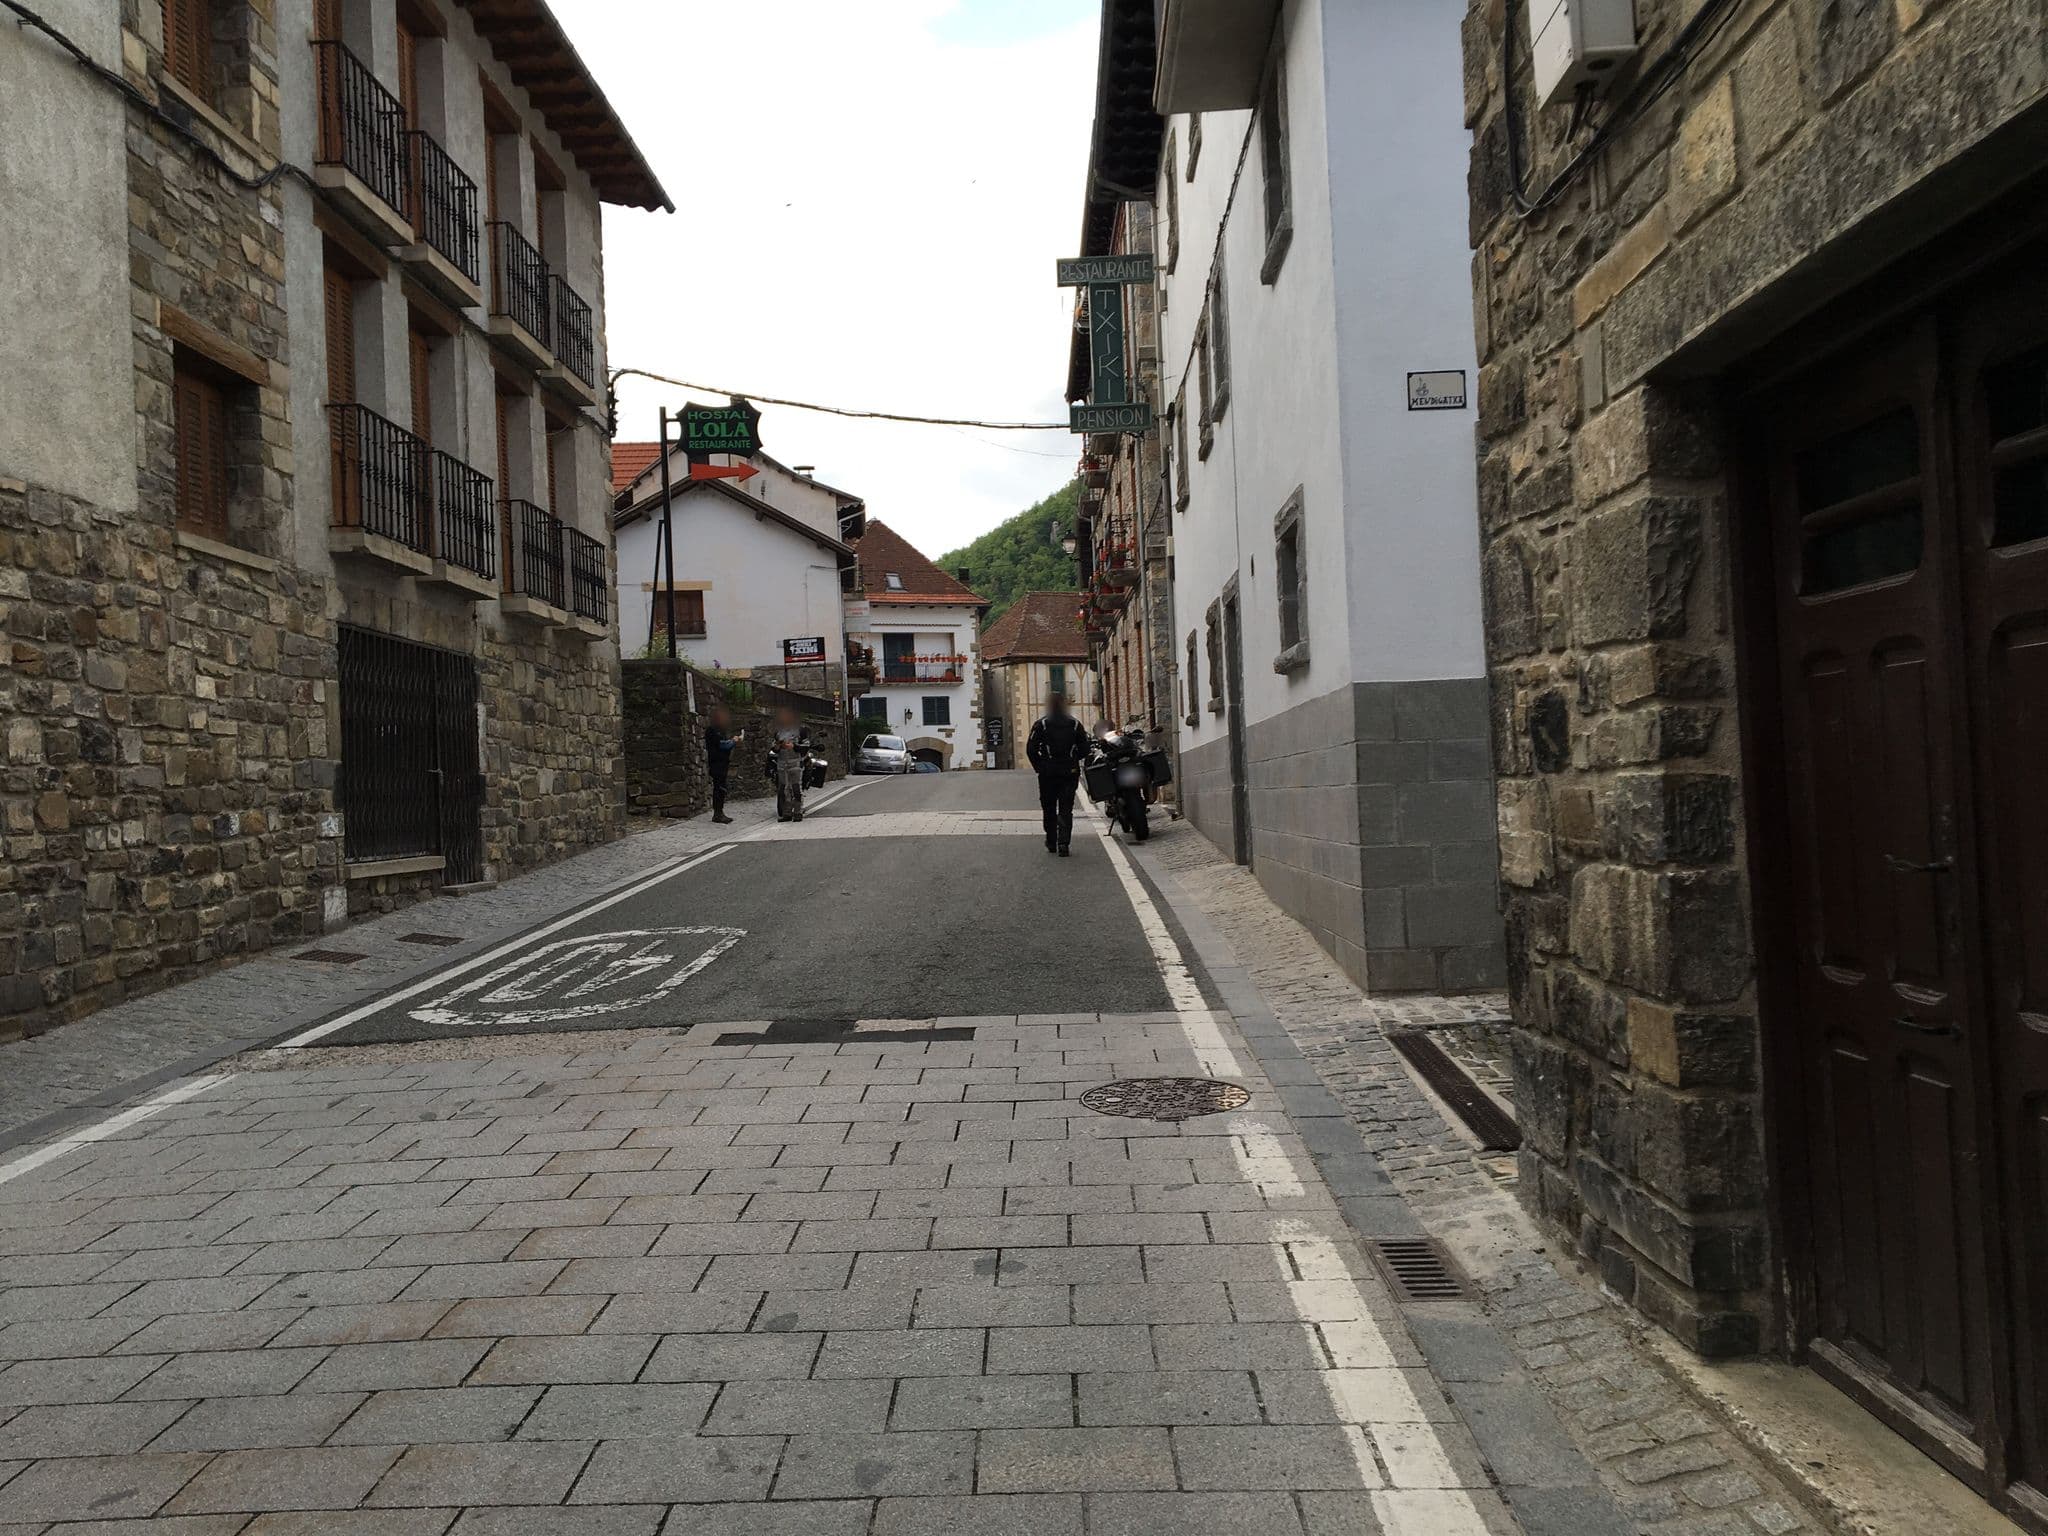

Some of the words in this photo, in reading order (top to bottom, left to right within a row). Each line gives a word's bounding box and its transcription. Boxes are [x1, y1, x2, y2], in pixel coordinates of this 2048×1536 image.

[1059, 260, 1151, 281] RESTAURANTE
[687, 410, 750, 420] HOSTAL
[1077, 408, 1144, 428] PENSION
[688, 422, 750, 437] LOLA
[688, 440, 751, 449] RESTAURANTE
